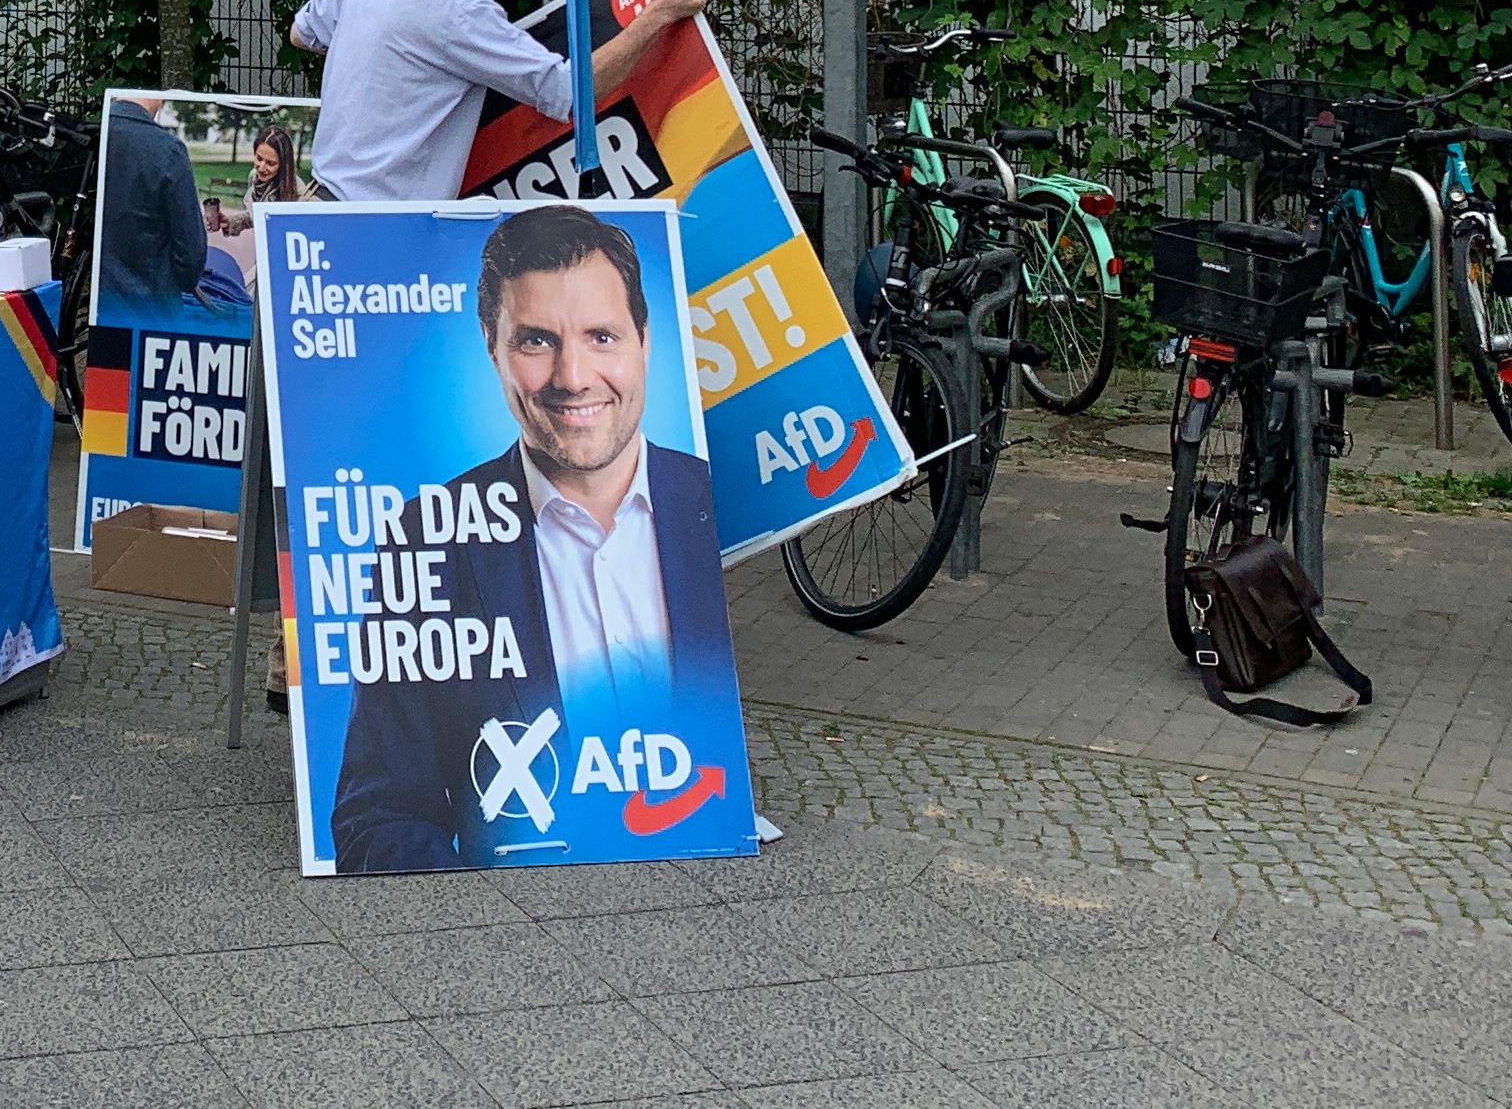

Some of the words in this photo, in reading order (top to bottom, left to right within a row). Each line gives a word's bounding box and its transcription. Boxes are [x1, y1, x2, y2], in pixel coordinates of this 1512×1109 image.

[285, 232, 331, 271] Dr.
[290, 274, 467, 315] Alexander
[292, 318, 357, 359] Sell
[689, 264, 806, 392] ST!
[143, 337, 251, 397] FAMI
[140, 396, 246, 462] FÖRD
[755, 405, 846, 486] AfD
[303, 468, 409, 548] FÜR
[419, 481, 522, 545] DAS
[308, 551, 451, 616] NEUE
[314, 617, 527, 685] EUROPA
[571, 728, 693, 794] AfD
